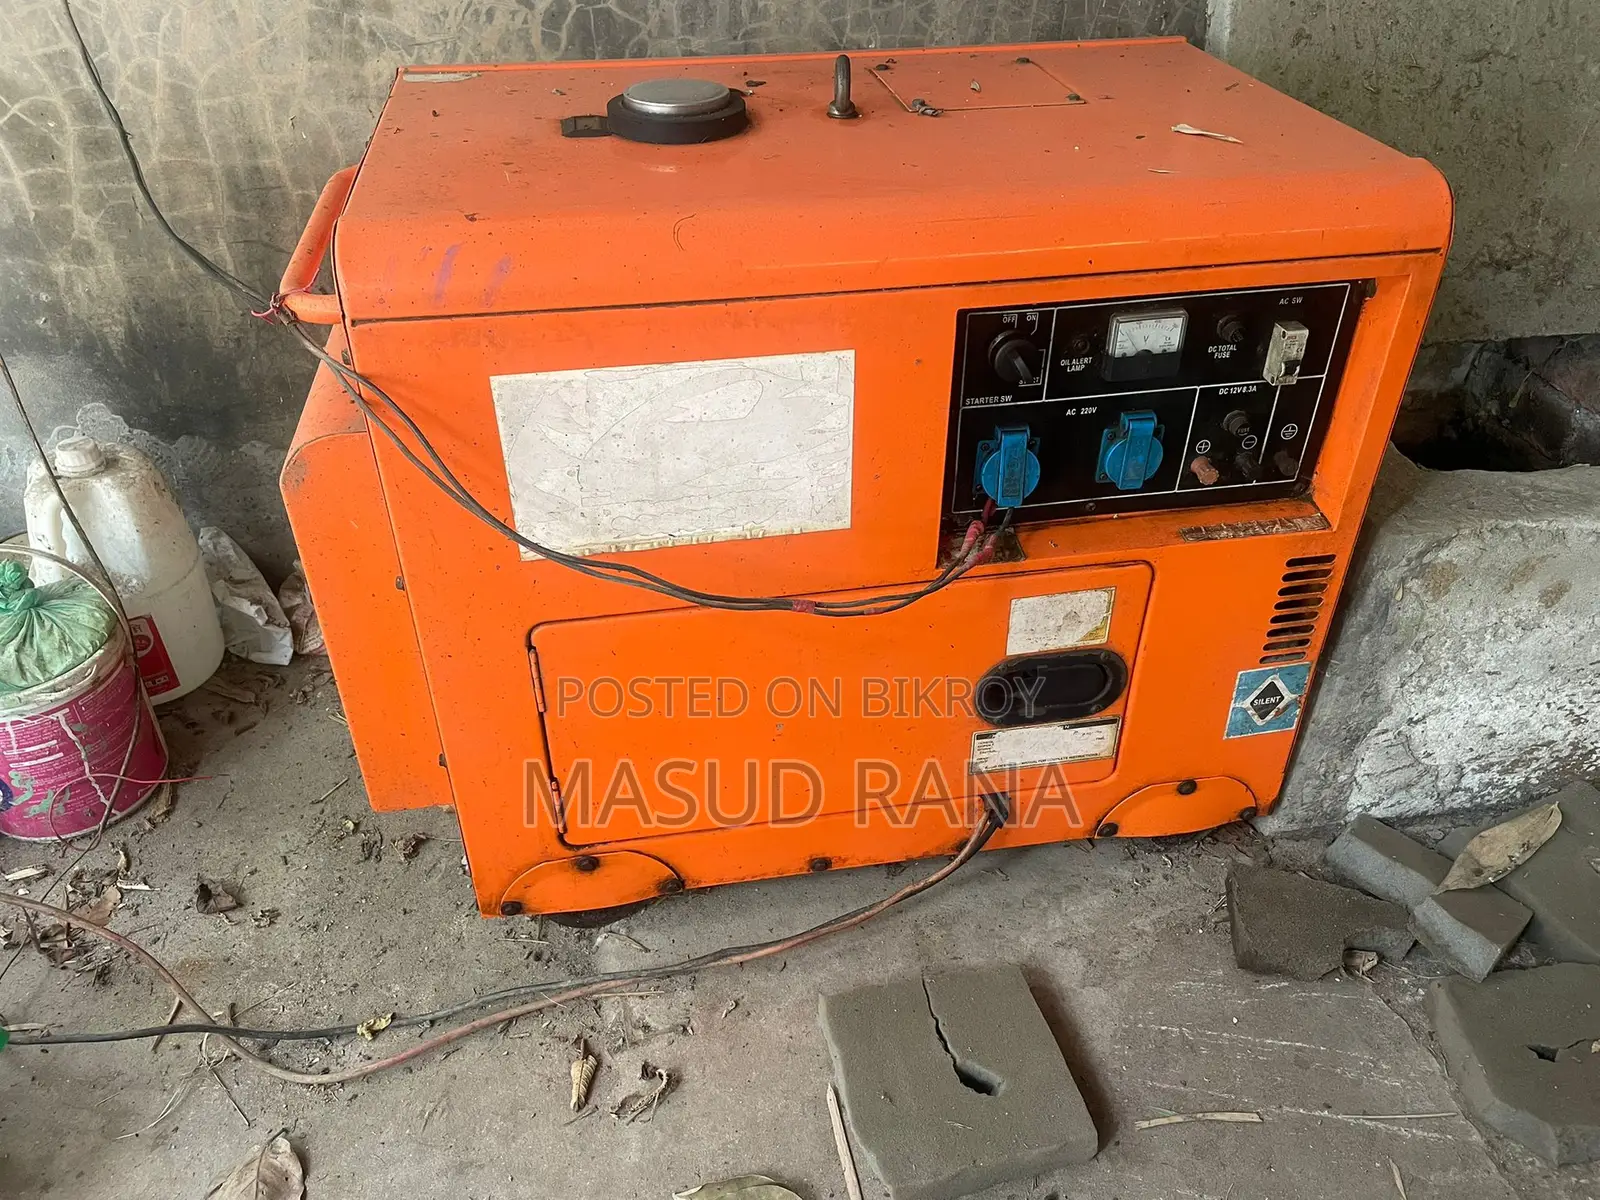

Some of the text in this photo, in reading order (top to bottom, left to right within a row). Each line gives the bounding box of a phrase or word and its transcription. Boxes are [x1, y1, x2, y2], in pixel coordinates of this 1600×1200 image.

[1002, 314, 1016, 324] OFF
[1026, 314, 1036, 322] ON
[1208, 344, 1237, 353] DC TOTAL
[1214, 351, 1230, 359] FUSE
[1060, 357, 1093, 367] OIL ALERT
[1066, 364, 1086, 373] LAMP
[1219, 385, 1257, 395] DC 12V 8.3A
[965, 395, 1013, 405] STARTER SW
[1066, 406, 1097, 416] AC 220V
[1253, 695, 1281, 706] SILENT
